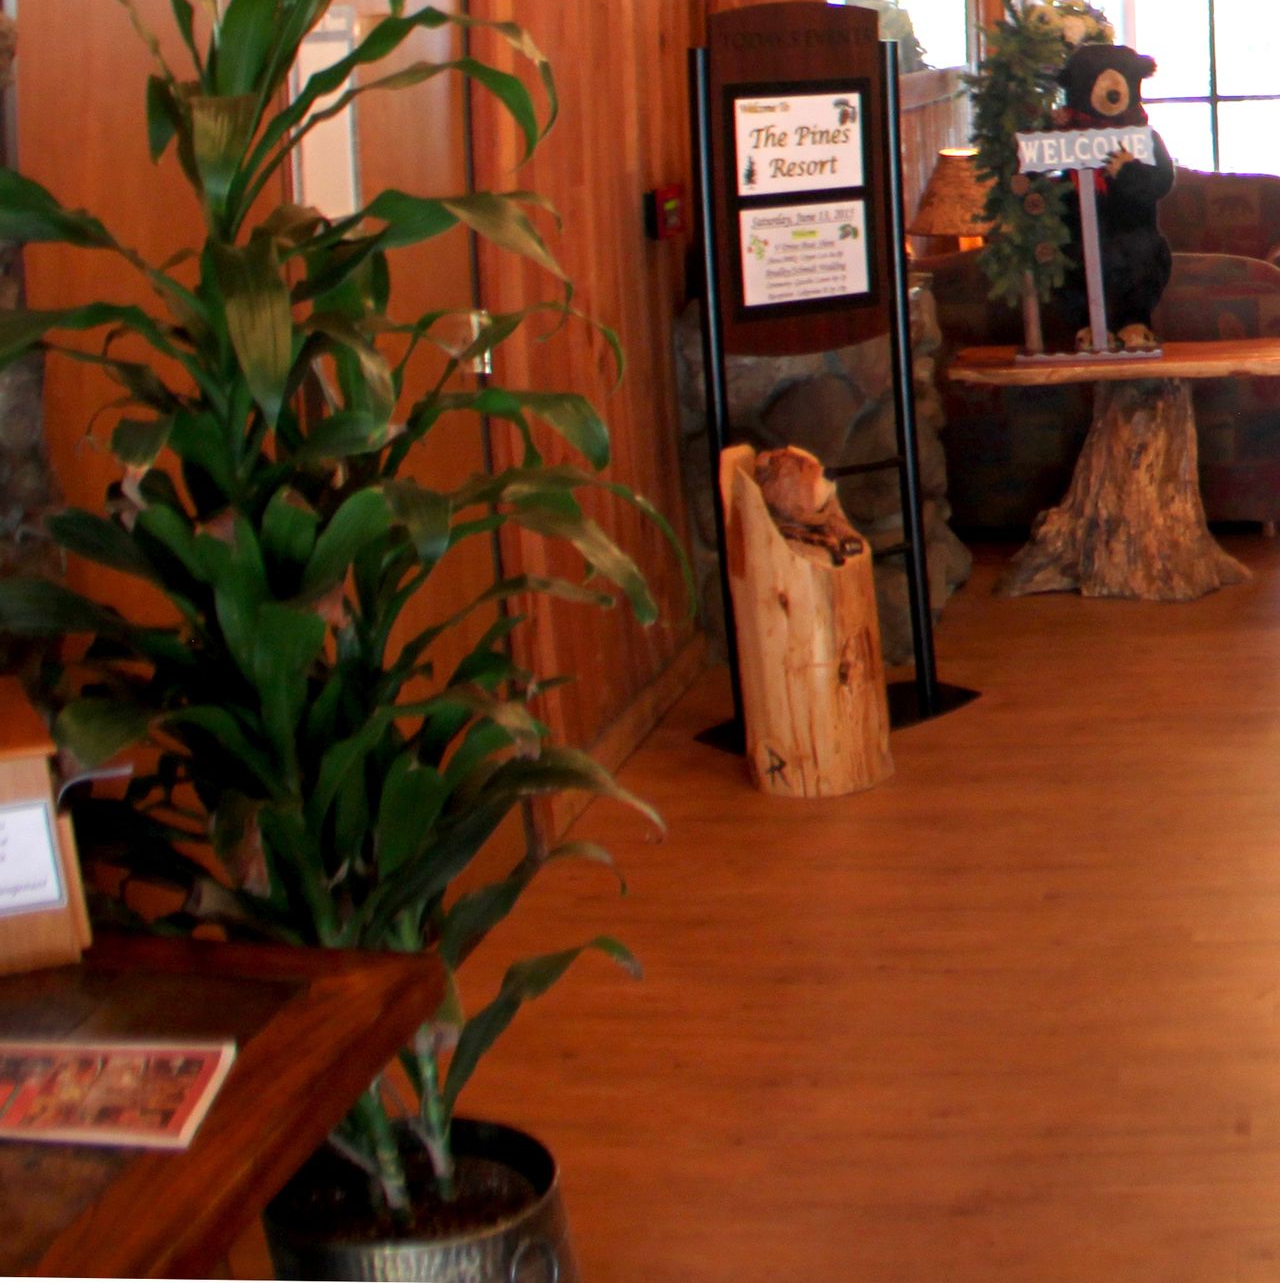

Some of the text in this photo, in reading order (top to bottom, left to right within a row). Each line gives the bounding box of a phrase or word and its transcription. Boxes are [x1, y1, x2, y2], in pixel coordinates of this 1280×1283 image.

[749, 124, 851, 149] The Pines
[769, 155, 838, 179] Resort
